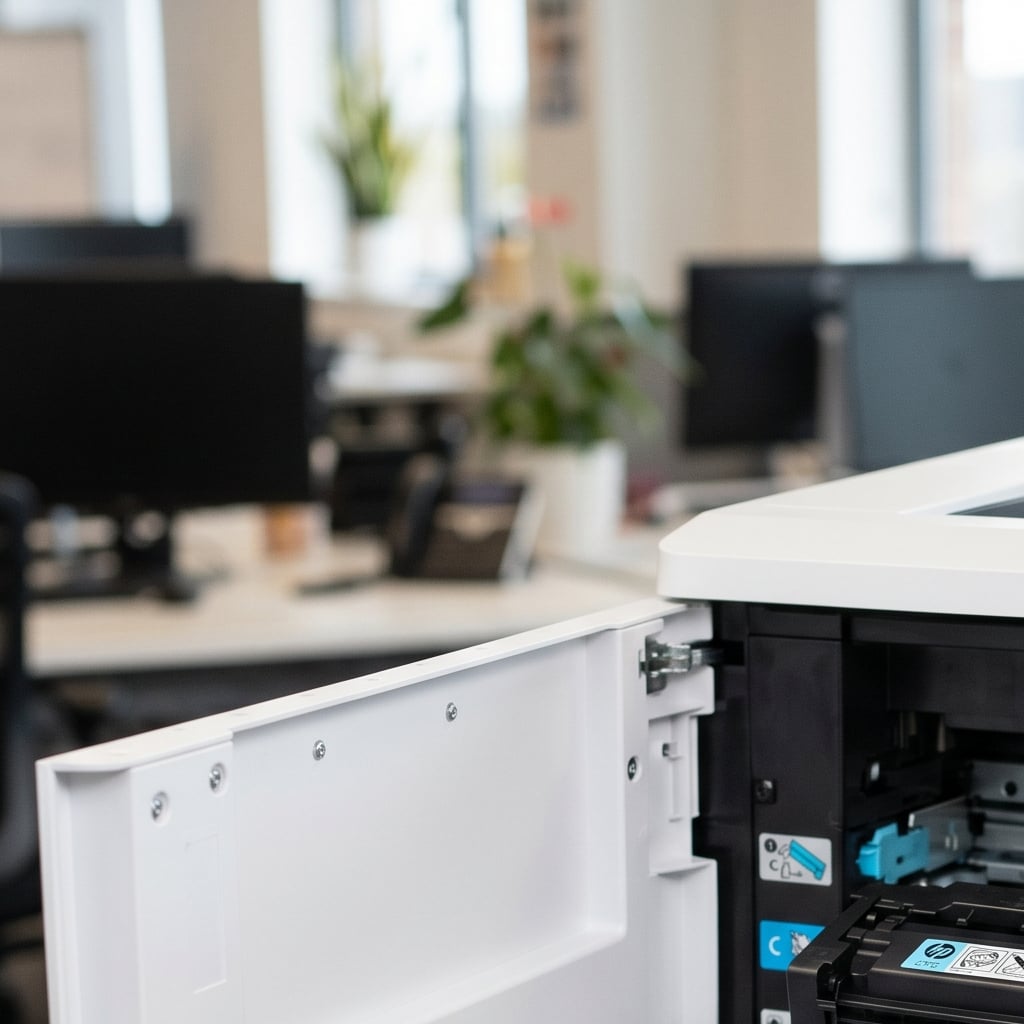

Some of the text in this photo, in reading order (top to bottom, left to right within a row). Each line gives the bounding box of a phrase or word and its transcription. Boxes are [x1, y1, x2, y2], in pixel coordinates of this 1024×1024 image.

[769, 859, 779, 872] C
[768, 935, 781, 957] C
[925, 943, 955, 959] hp
